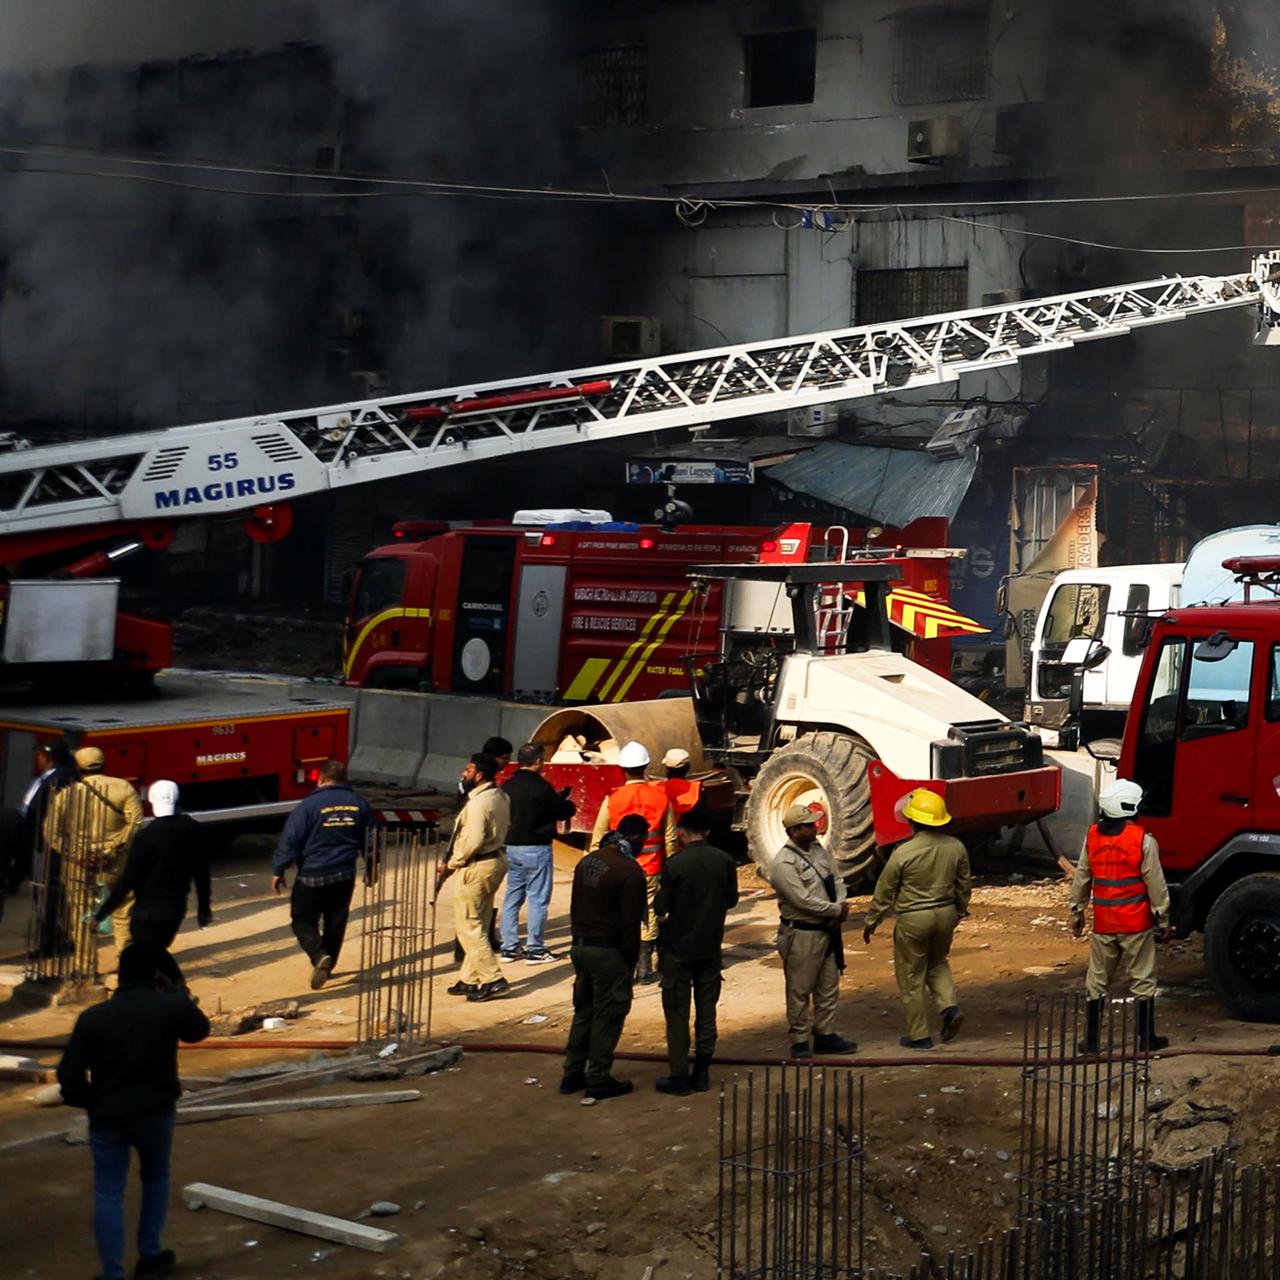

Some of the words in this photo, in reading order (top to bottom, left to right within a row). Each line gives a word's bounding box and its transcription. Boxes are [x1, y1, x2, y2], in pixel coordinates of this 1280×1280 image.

[207, 451, 240, 471] 55
[154, 472, 297, 510] MAGIRUS
[1076, 507, 1092, 569] TRADERS
[196, 751, 247, 765] MAGIRUS
